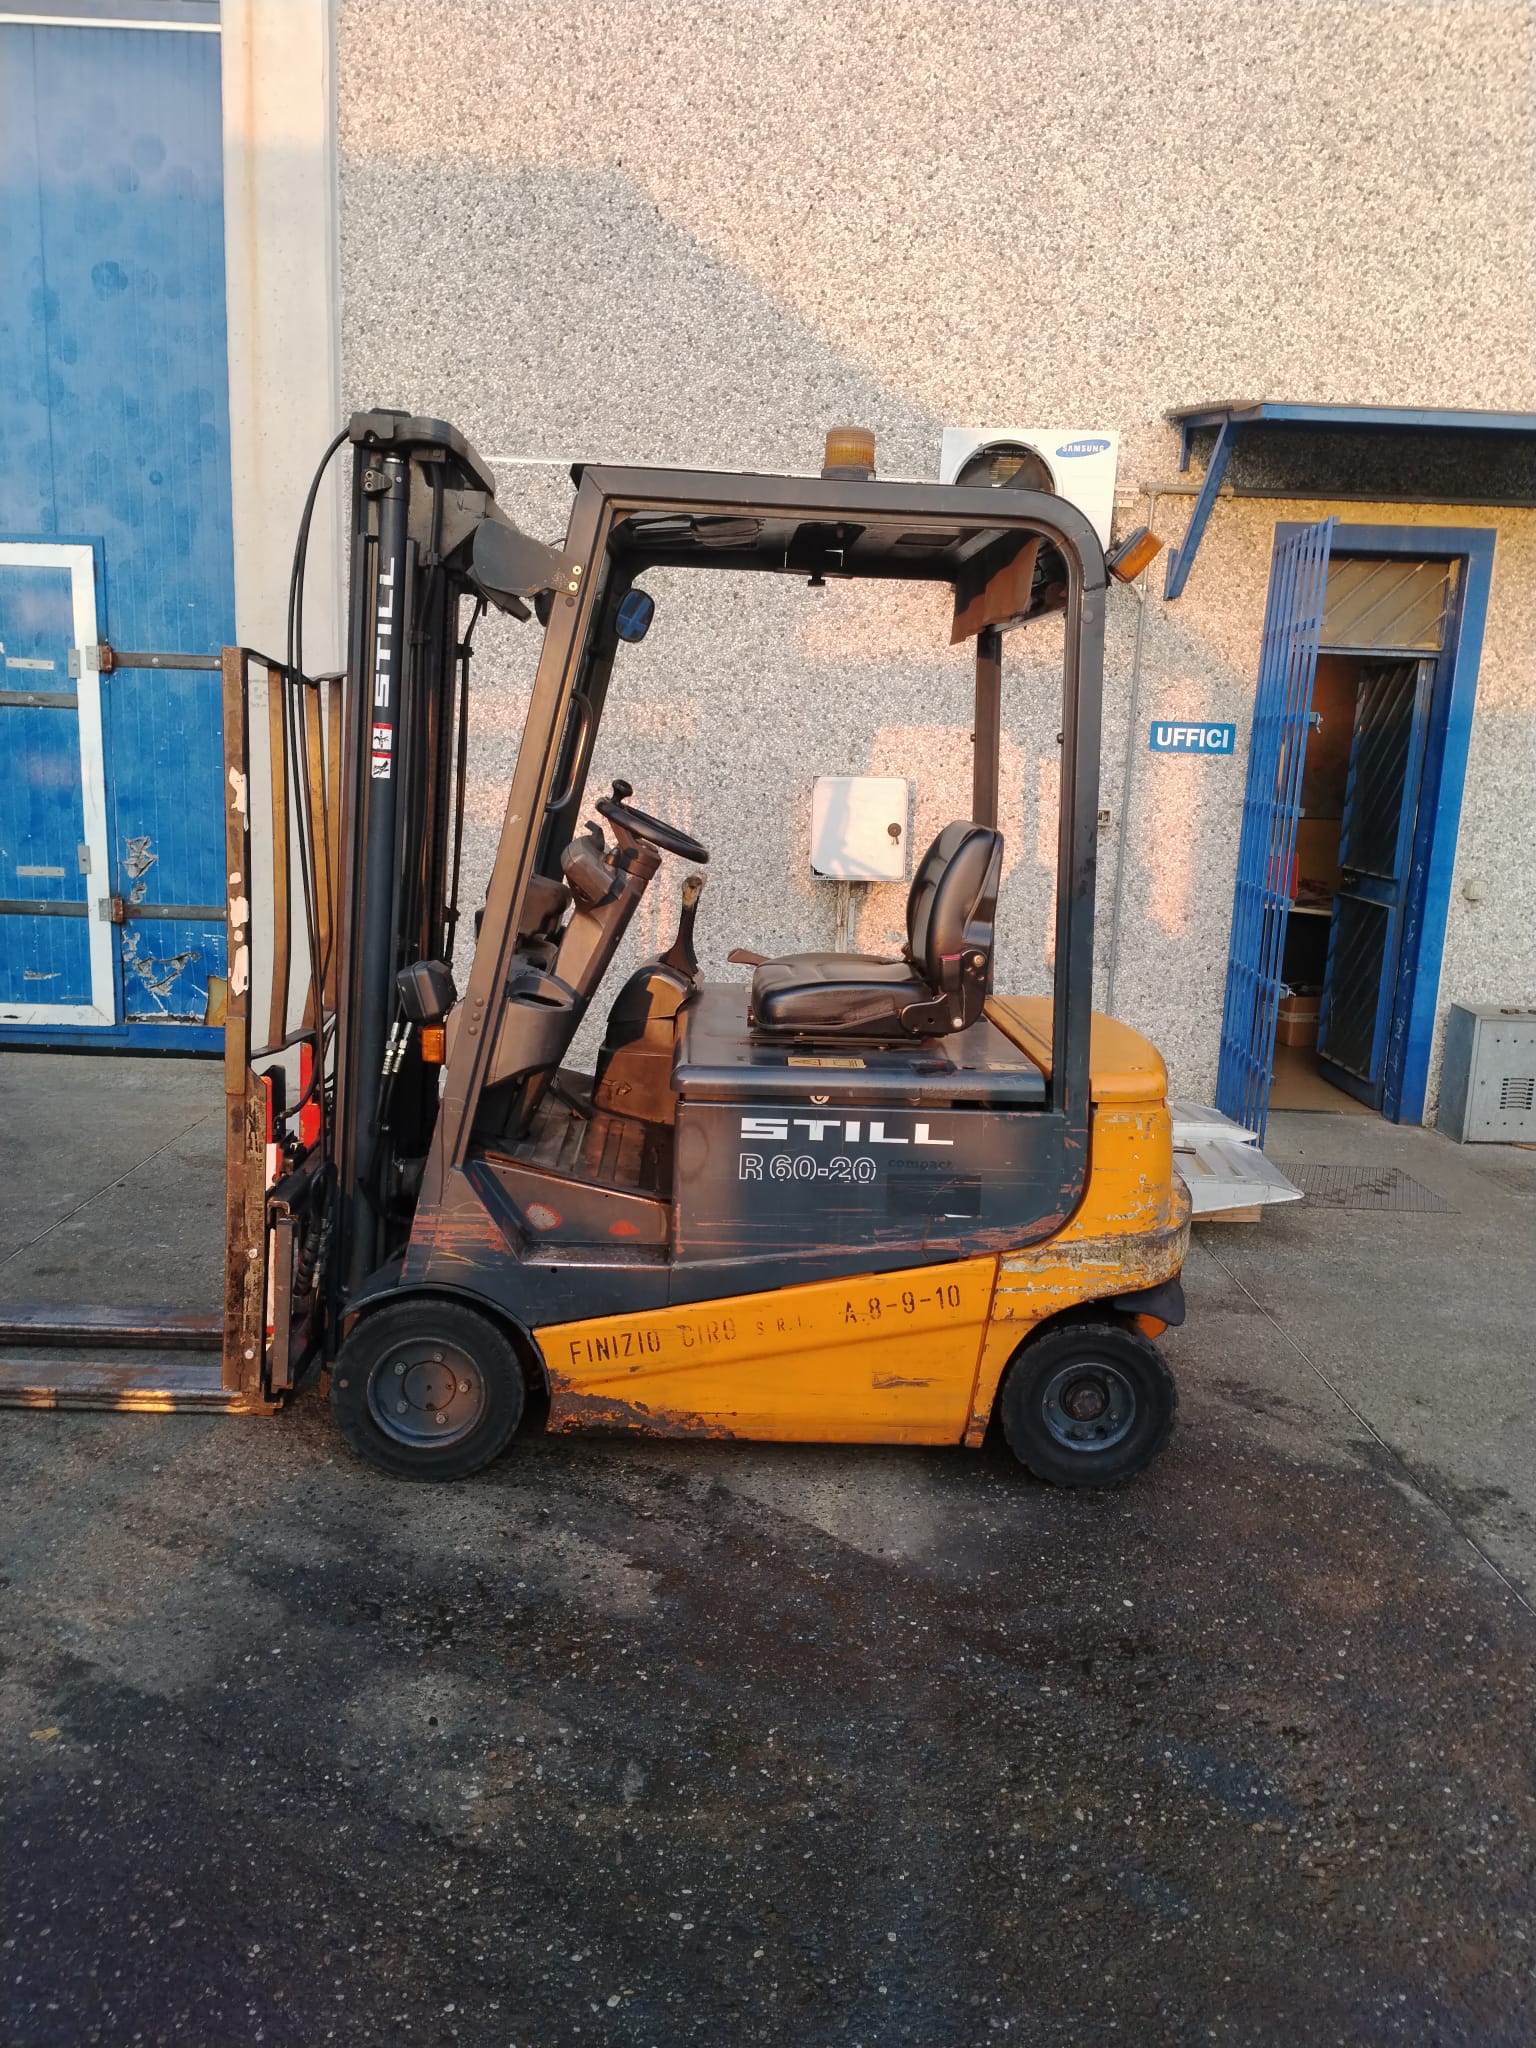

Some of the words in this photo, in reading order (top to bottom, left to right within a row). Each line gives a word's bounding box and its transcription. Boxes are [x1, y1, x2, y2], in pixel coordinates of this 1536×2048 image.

[1062, 444, 1105, 453] SAMSUNG
[374, 556, 395, 708] STILL
[1156, 727, 1229, 748] UFFICI
[740, 1117, 954, 1146] STILL
[738, 1153, 764, 1181] R
[769, 1154, 877, 1184] 60-20
[569, 1331, 661, 1365] FINIZIO
